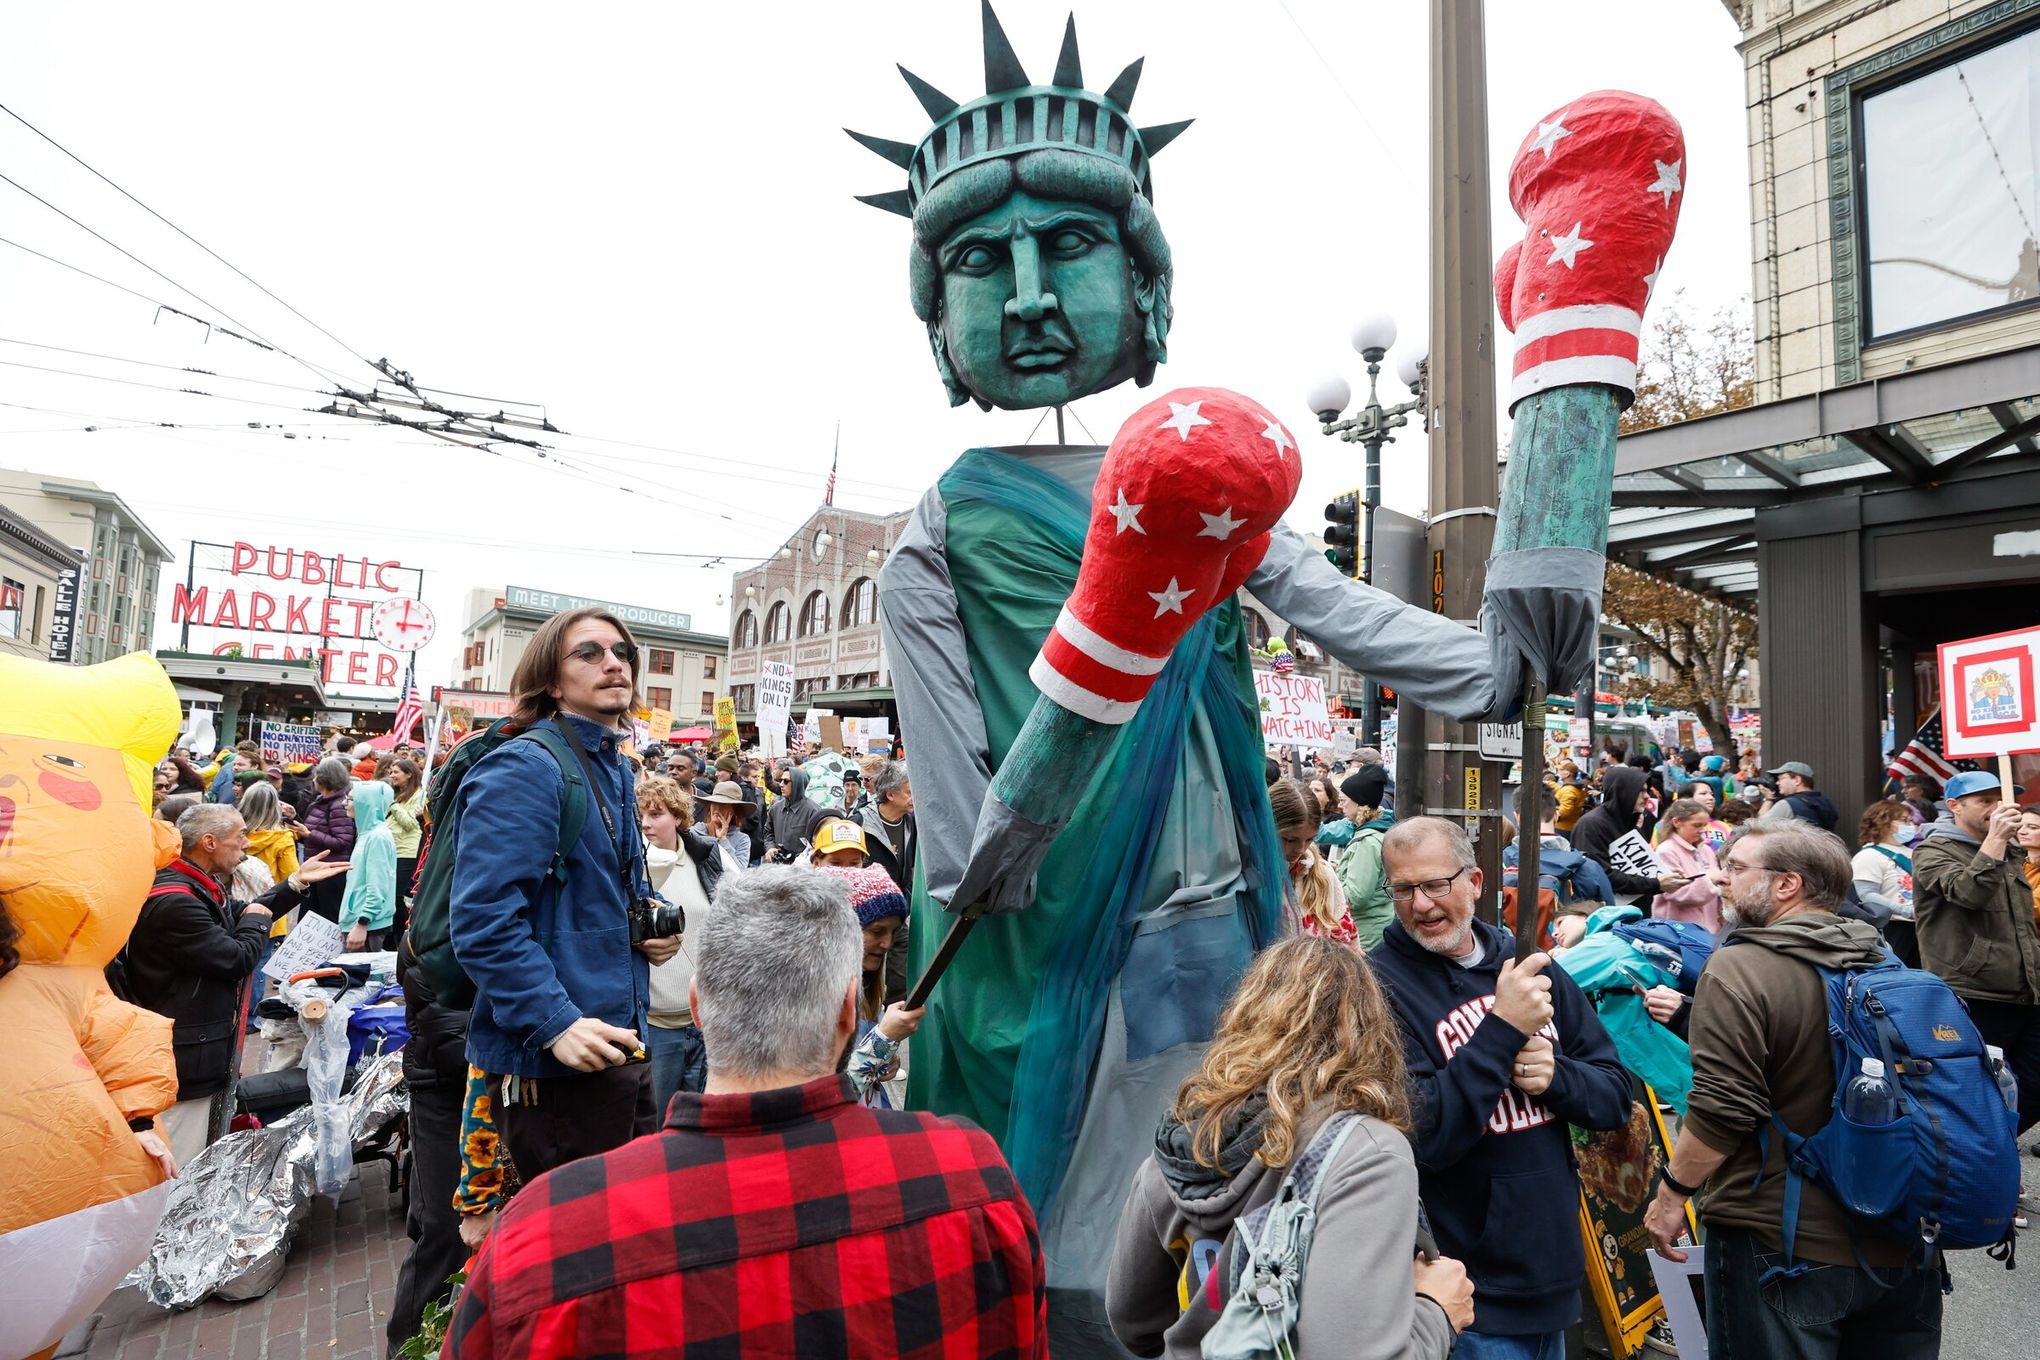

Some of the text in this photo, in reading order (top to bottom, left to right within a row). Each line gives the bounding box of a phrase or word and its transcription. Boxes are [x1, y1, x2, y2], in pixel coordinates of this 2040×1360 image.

[231, 541, 401, 593] PUBLIC
[171, 583, 374, 640] MARKET
[515, 589, 560, 608] MEET
[607, 604, 686, 628] PRODUCER
[50, 615, 71, 660] HOTEL
[772, 664, 785, 677] NO
[761, 677, 792, 694] KINGS
[1254, 673, 1322, 704] HISTORY
[762, 692, 789, 708] ONLY
[1280, 697, 1301, 716] IS
[262, 731, 277, 741] NO
[266, 722, 282, 732] NO
[263, 740, 280, 750] NO
[263, 749, 320, 765] NO KINGS
[1618, 836, 1664, 877] KING
